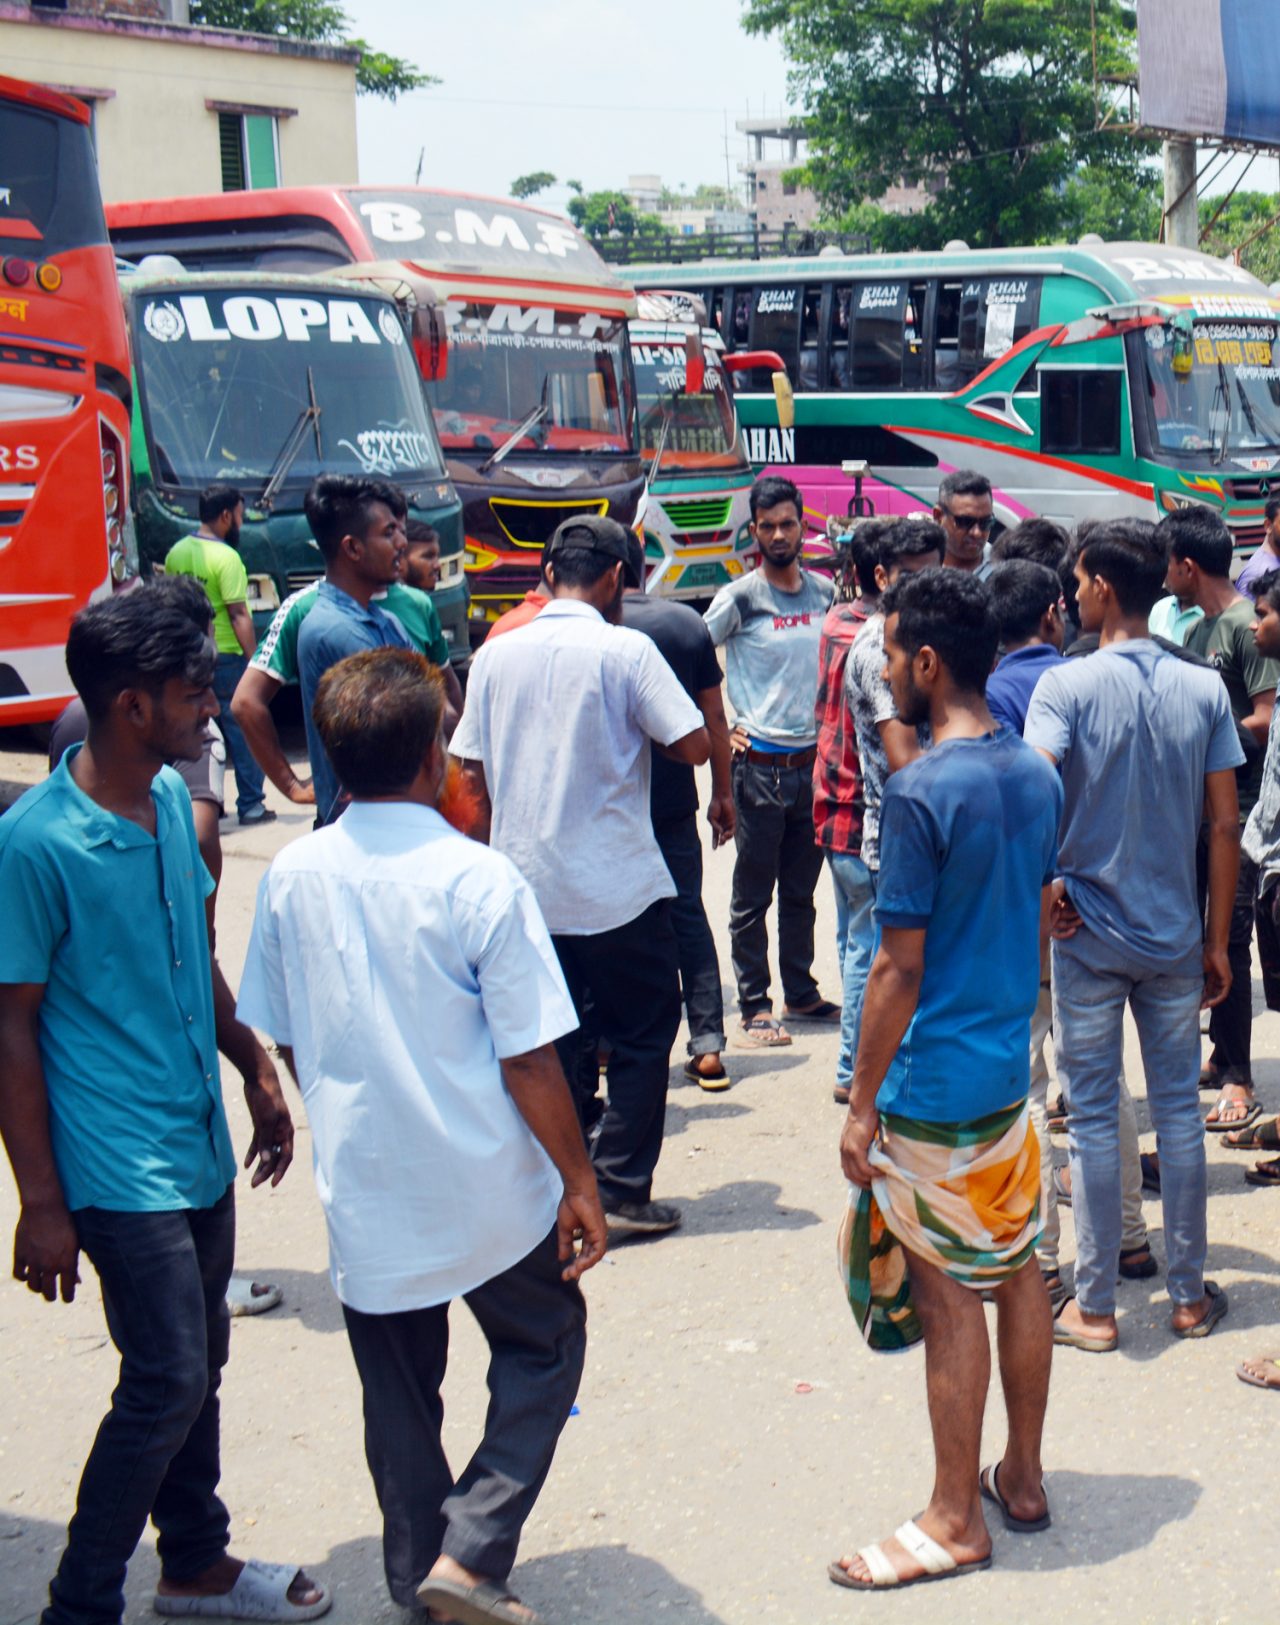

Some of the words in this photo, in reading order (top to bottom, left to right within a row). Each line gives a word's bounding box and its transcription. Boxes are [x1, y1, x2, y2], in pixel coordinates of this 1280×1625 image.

[360, 202, 579, 257] B.M.F
[863, 286, 900, 299] KHAN
[988, 281, 1029, 294] KHAN
[760, 290, 796, 301] KHAN
[859, 295, 898, 309] Express
[757, 298, 794, 313] Express
[1190, 296, 1276, 318] EXCLUSIVE
[179, 296, 381, 344] LOPA
